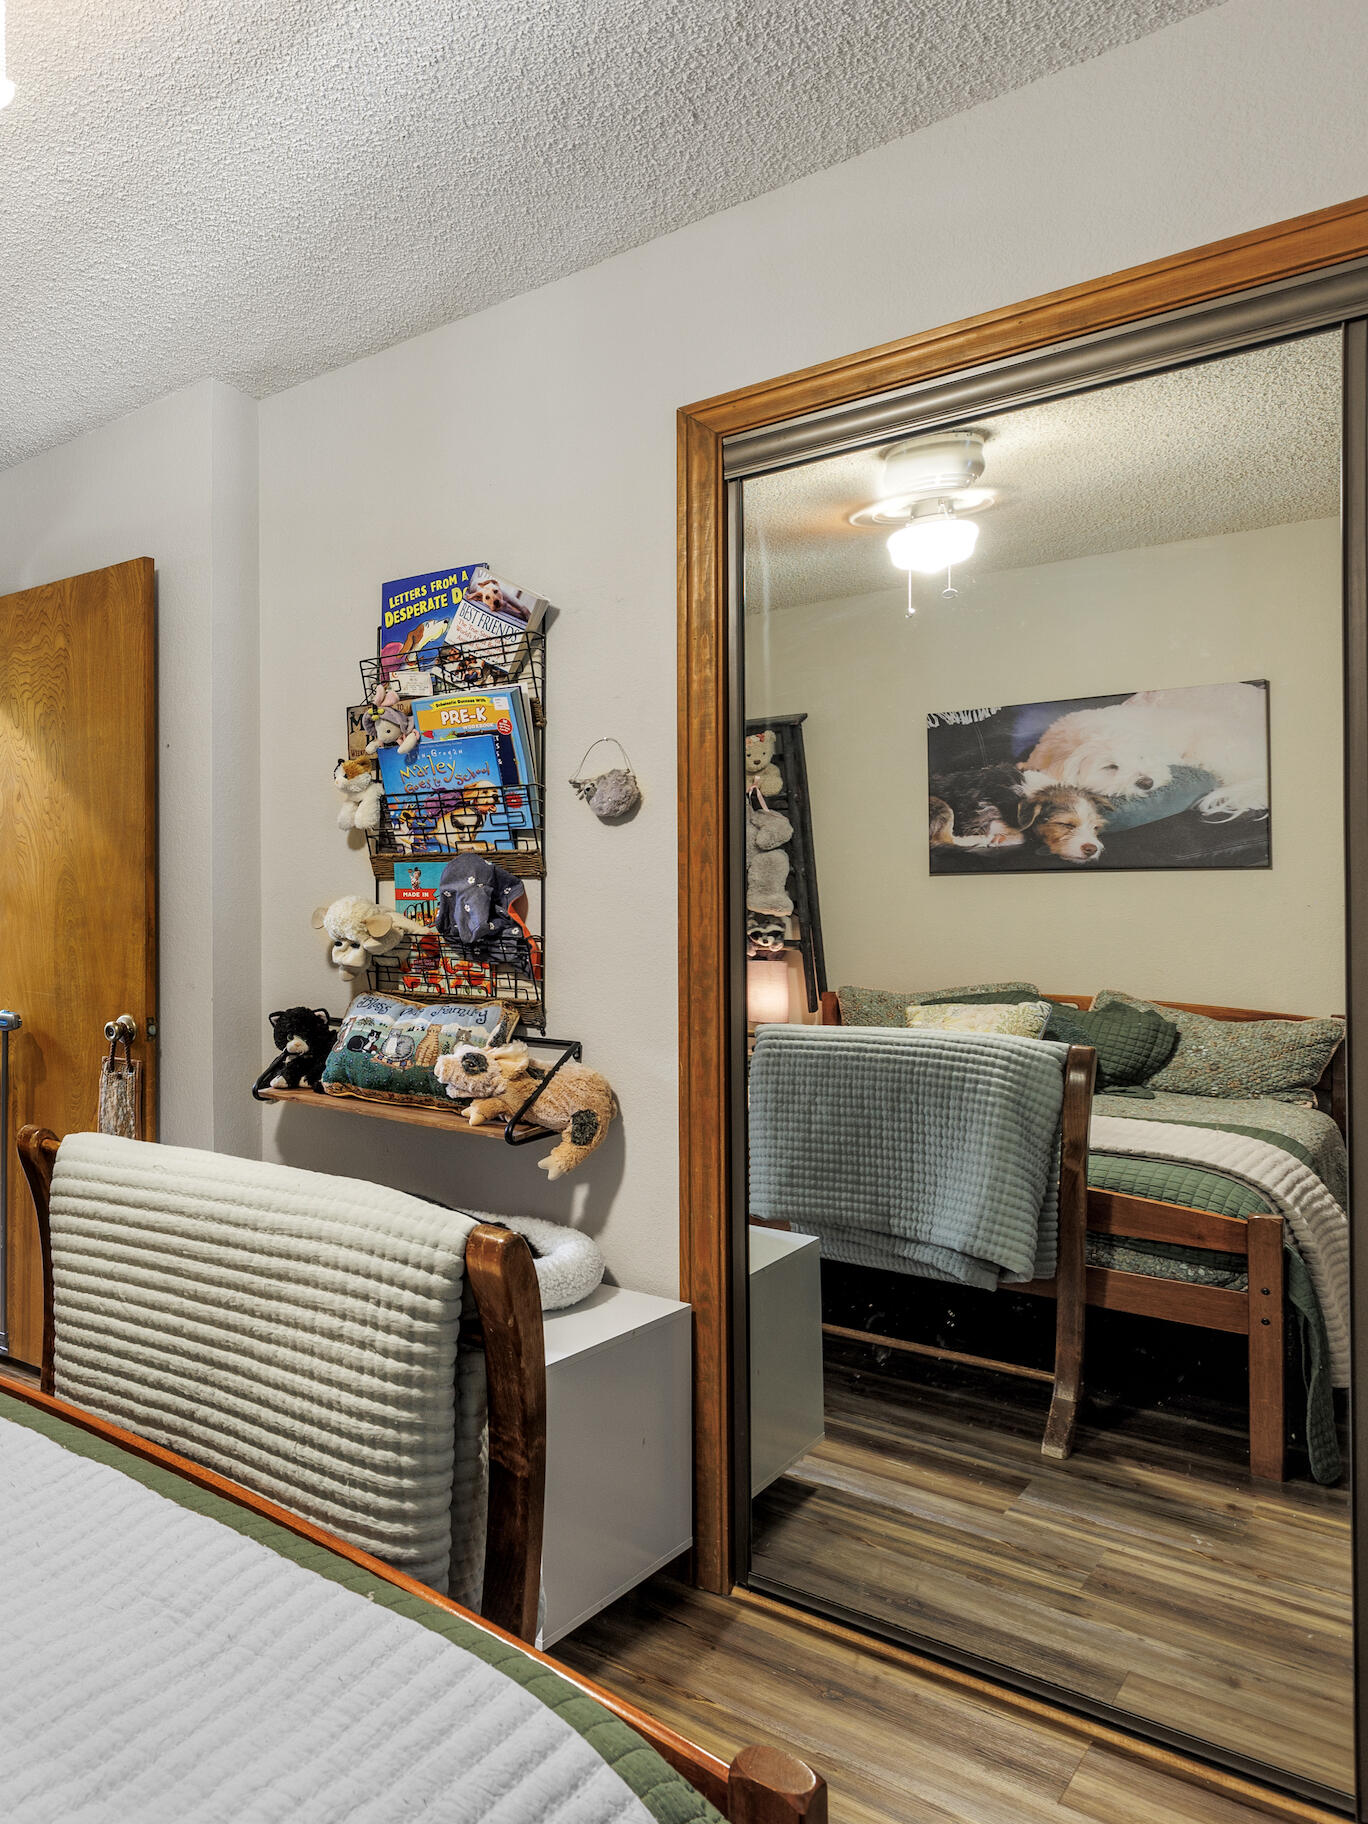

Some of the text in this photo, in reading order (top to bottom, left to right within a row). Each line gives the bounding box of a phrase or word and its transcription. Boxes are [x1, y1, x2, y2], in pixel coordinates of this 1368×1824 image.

[389, 585, 427, 609] LETTERS
[431, 574, 457, 592] FROM
[462, 570, 469, 581] A
[384, 594, 448, 628] DESPERATE
[459, 602, 521, 642] BEST FRIENDS
[440, 706, 487, 725] PRE-K
[399, 755, 456, 783] Marley
[356, 998, 392, 1015] Bless
